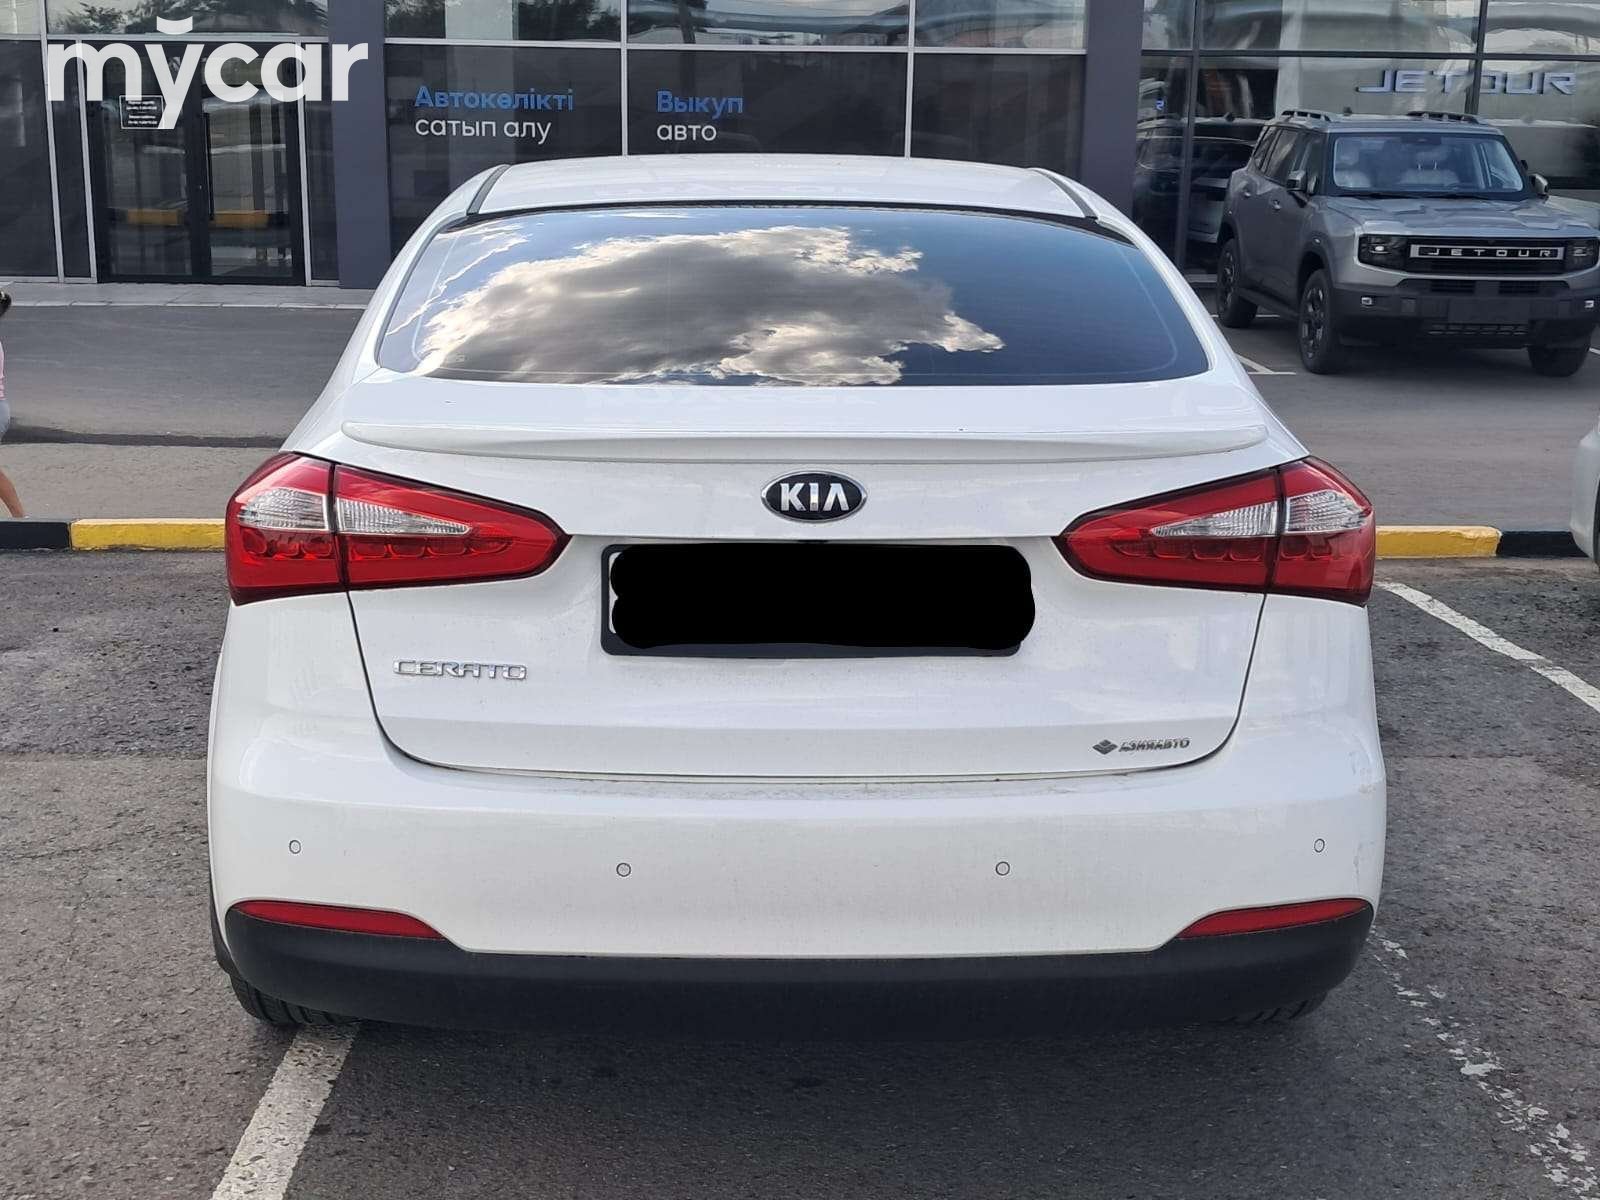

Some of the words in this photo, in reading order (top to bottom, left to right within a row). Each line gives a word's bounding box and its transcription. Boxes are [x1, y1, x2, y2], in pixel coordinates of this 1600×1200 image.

[414, 85, 574, 112] Автокөлікті
[657, 90, 743, 120] Выкуп
[415, 119, 496, 137] сатып
[503, 121, 551, 144] алу
[657, 124, 717, 141] авто
[1427, 248, 1551, 257] JETOUR
[779, 482, 850, 511] KIA
[393, 660, 527, 680] CERATO
